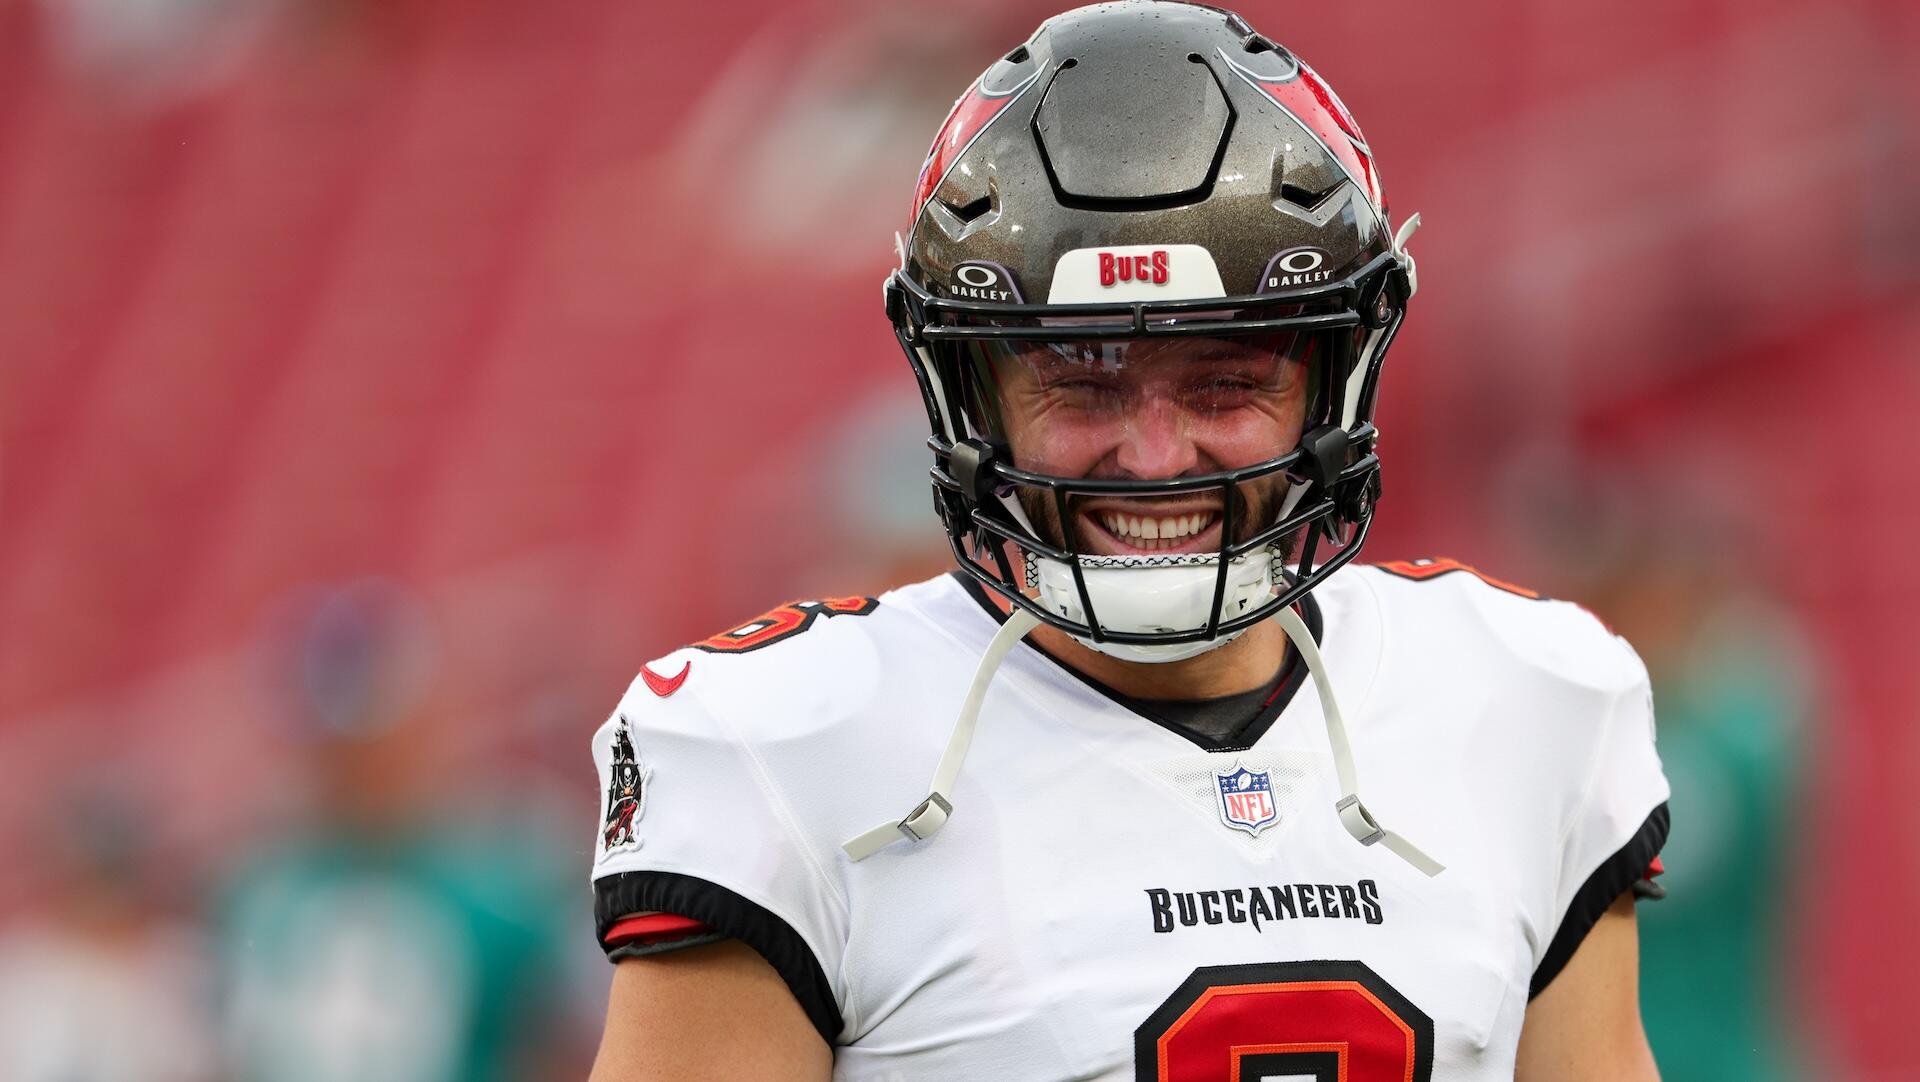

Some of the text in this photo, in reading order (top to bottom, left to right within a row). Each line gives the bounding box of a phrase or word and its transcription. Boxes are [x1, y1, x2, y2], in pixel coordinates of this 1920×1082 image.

[1098, 250, 1168, 287] BUCS
[1268, 270, 1331, 288] OAKLEY
[951, 284, 1009, 301] OAKLEY
[1227, 792, 1273, 822] NFL
[1144, 879, 1384, 934] BUCCANEERS
